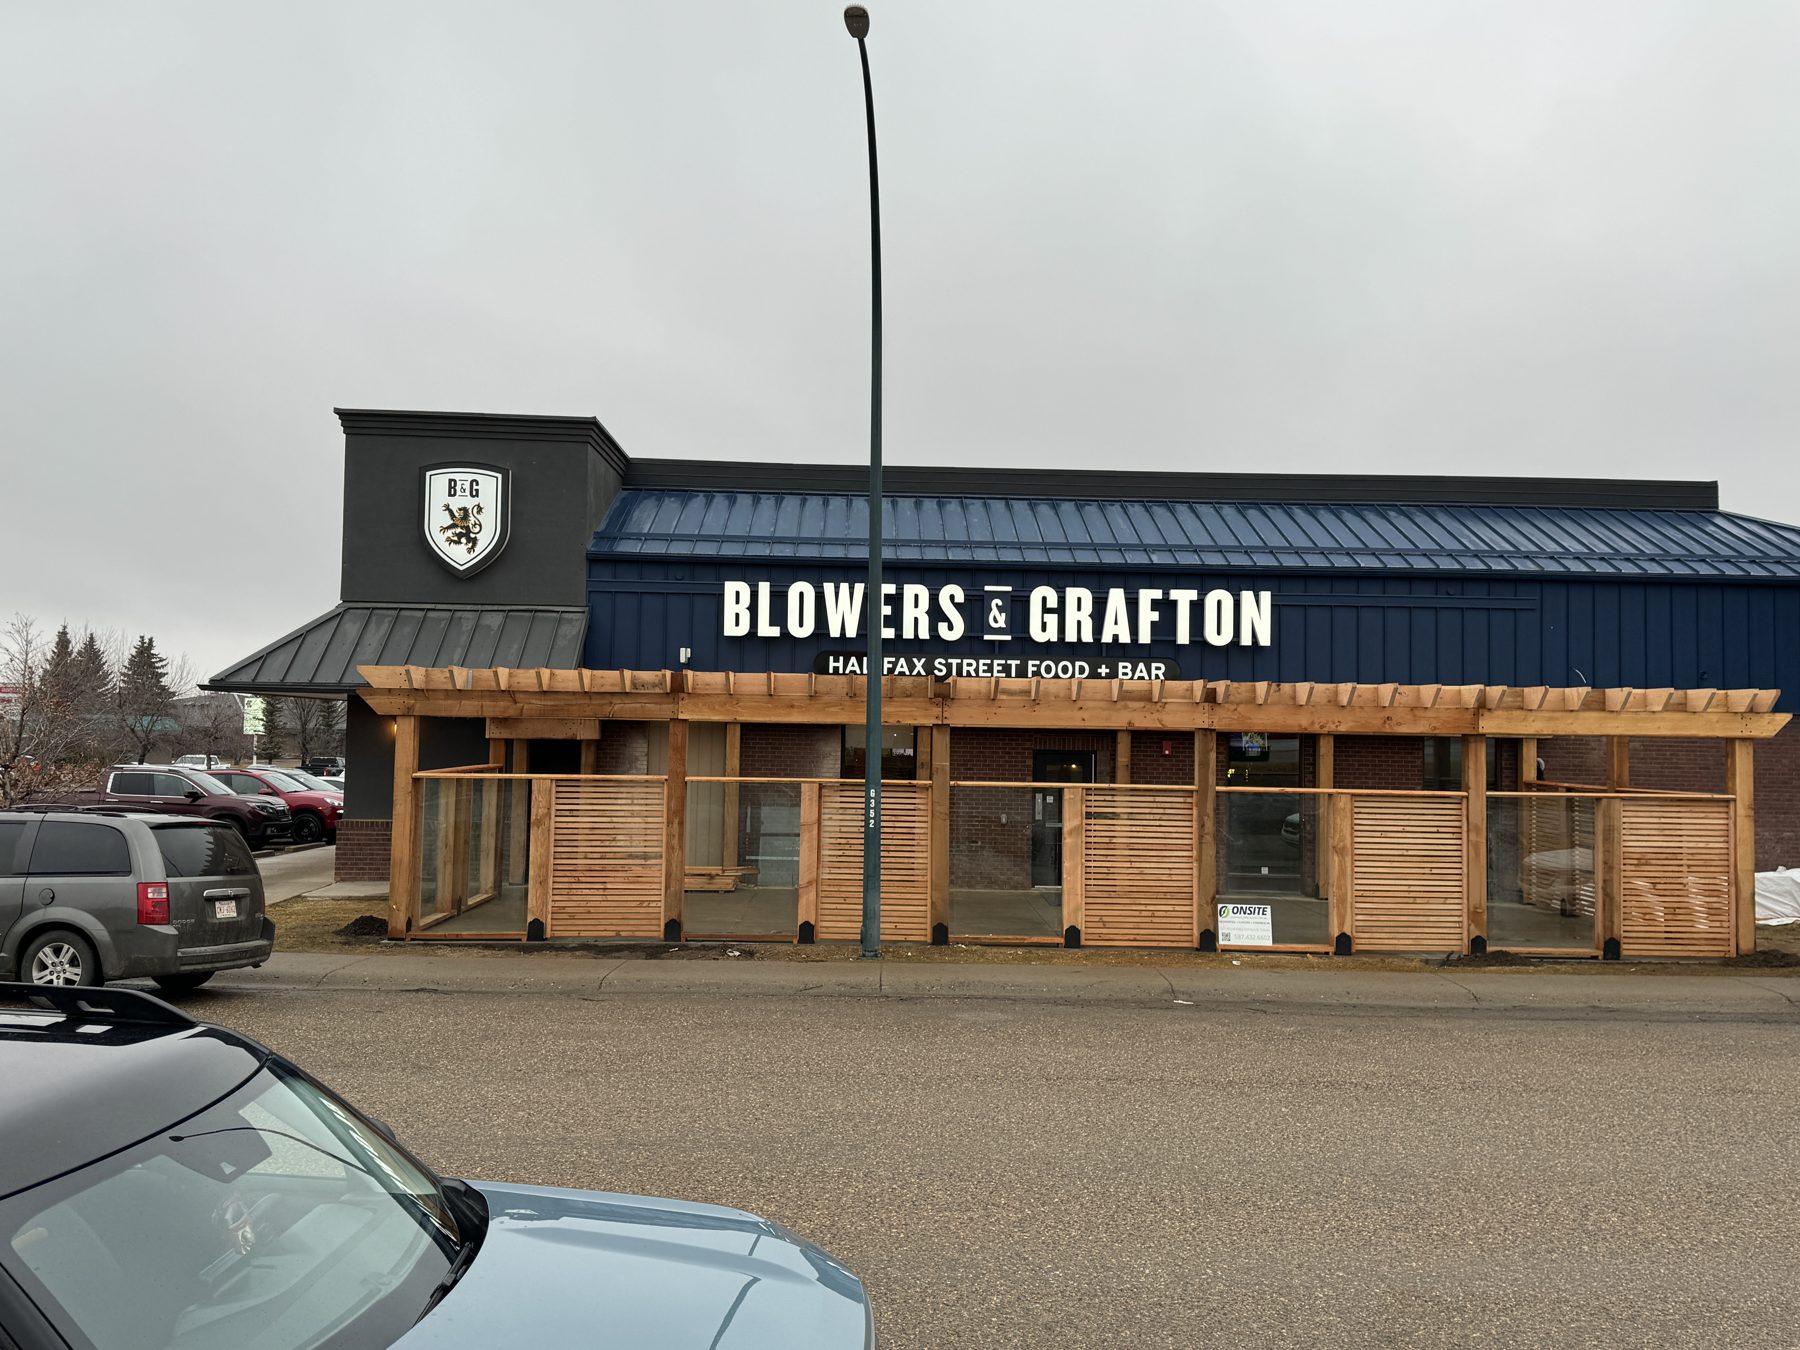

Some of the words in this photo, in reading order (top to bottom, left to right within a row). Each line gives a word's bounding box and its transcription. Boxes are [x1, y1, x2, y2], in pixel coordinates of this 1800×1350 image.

[723, 581, 965, 641] BLOWERS
[988, 599, 1007, 628] &
[1029, 586, 1272, 647] GRAFTON
[828, 655, 927, 676] HALFAX
[933, 658, 1020, 677] STREET
[1027, 660, 1090, 678] FOOD
[1117, 662, 1166, 680] BAR
[1231, 905, 1268, 916] ONSITE
